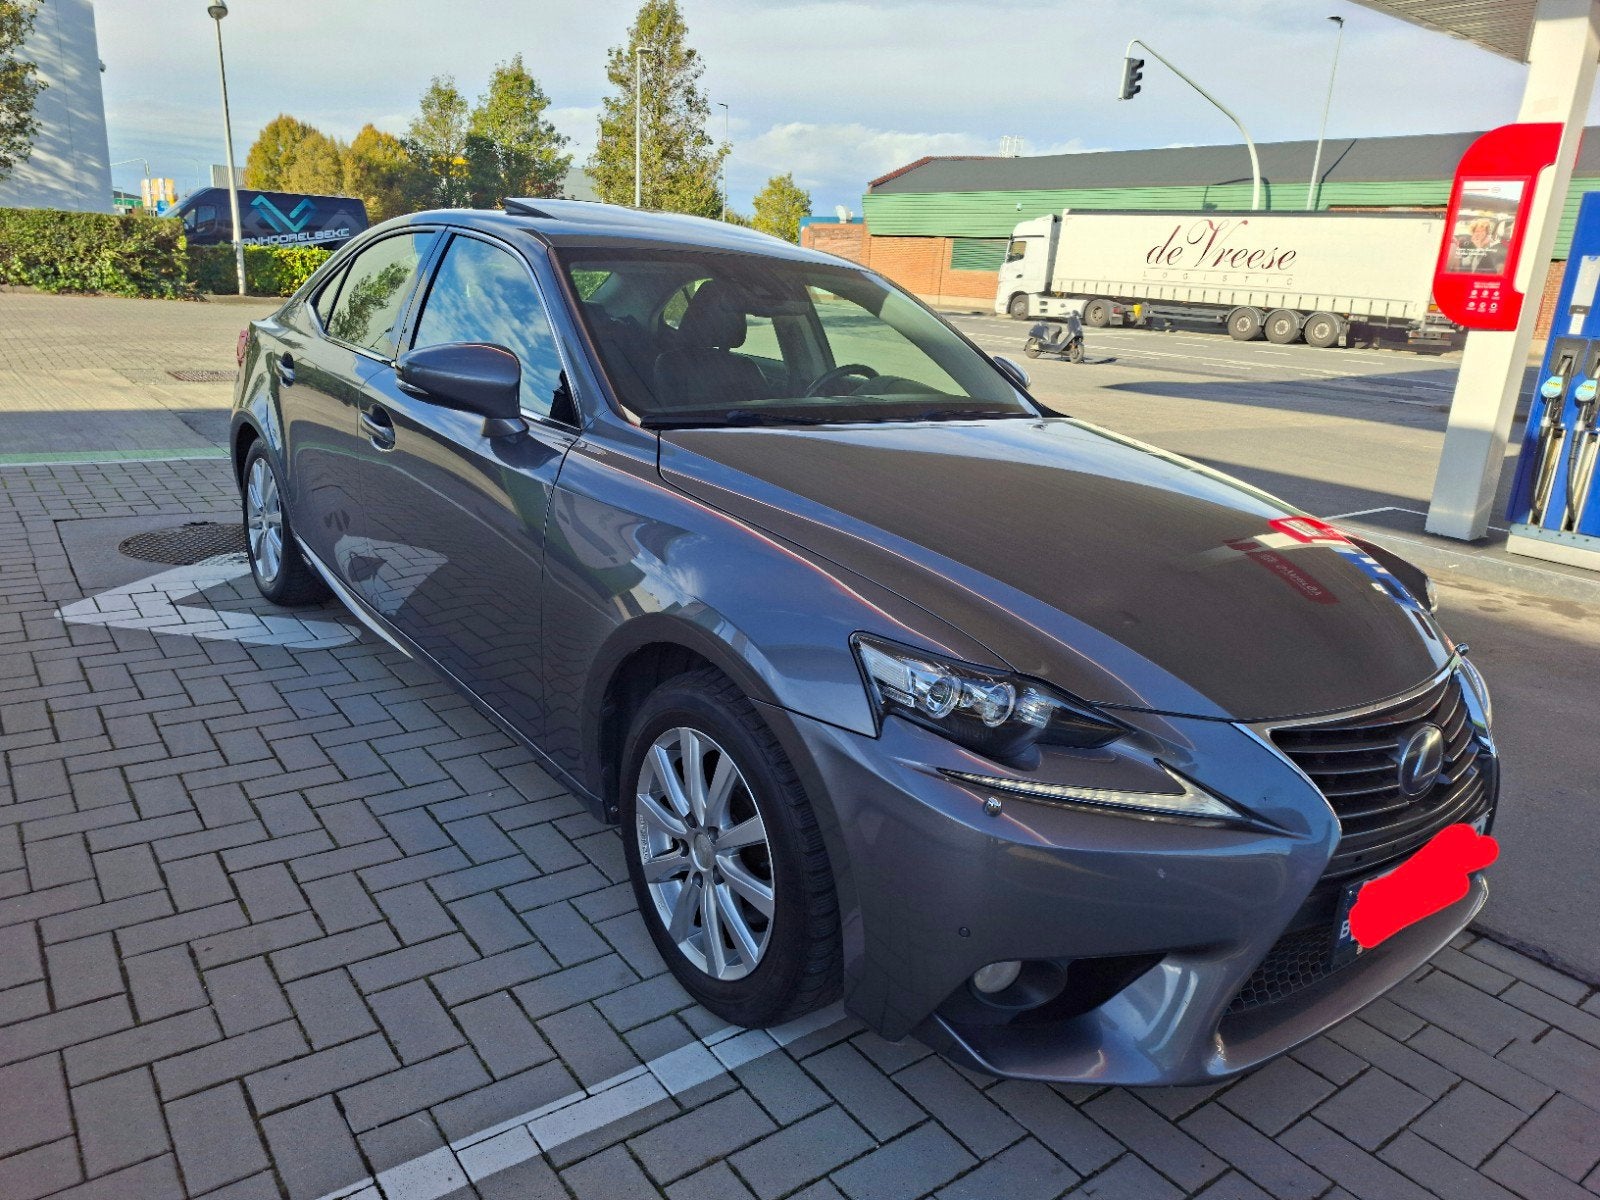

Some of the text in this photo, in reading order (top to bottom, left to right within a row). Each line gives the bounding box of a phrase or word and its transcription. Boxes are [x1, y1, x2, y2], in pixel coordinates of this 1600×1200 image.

[234, 228, 350, 246] ANHOORELBEKE
[1146, 219, 1297, 271] de Vreese
